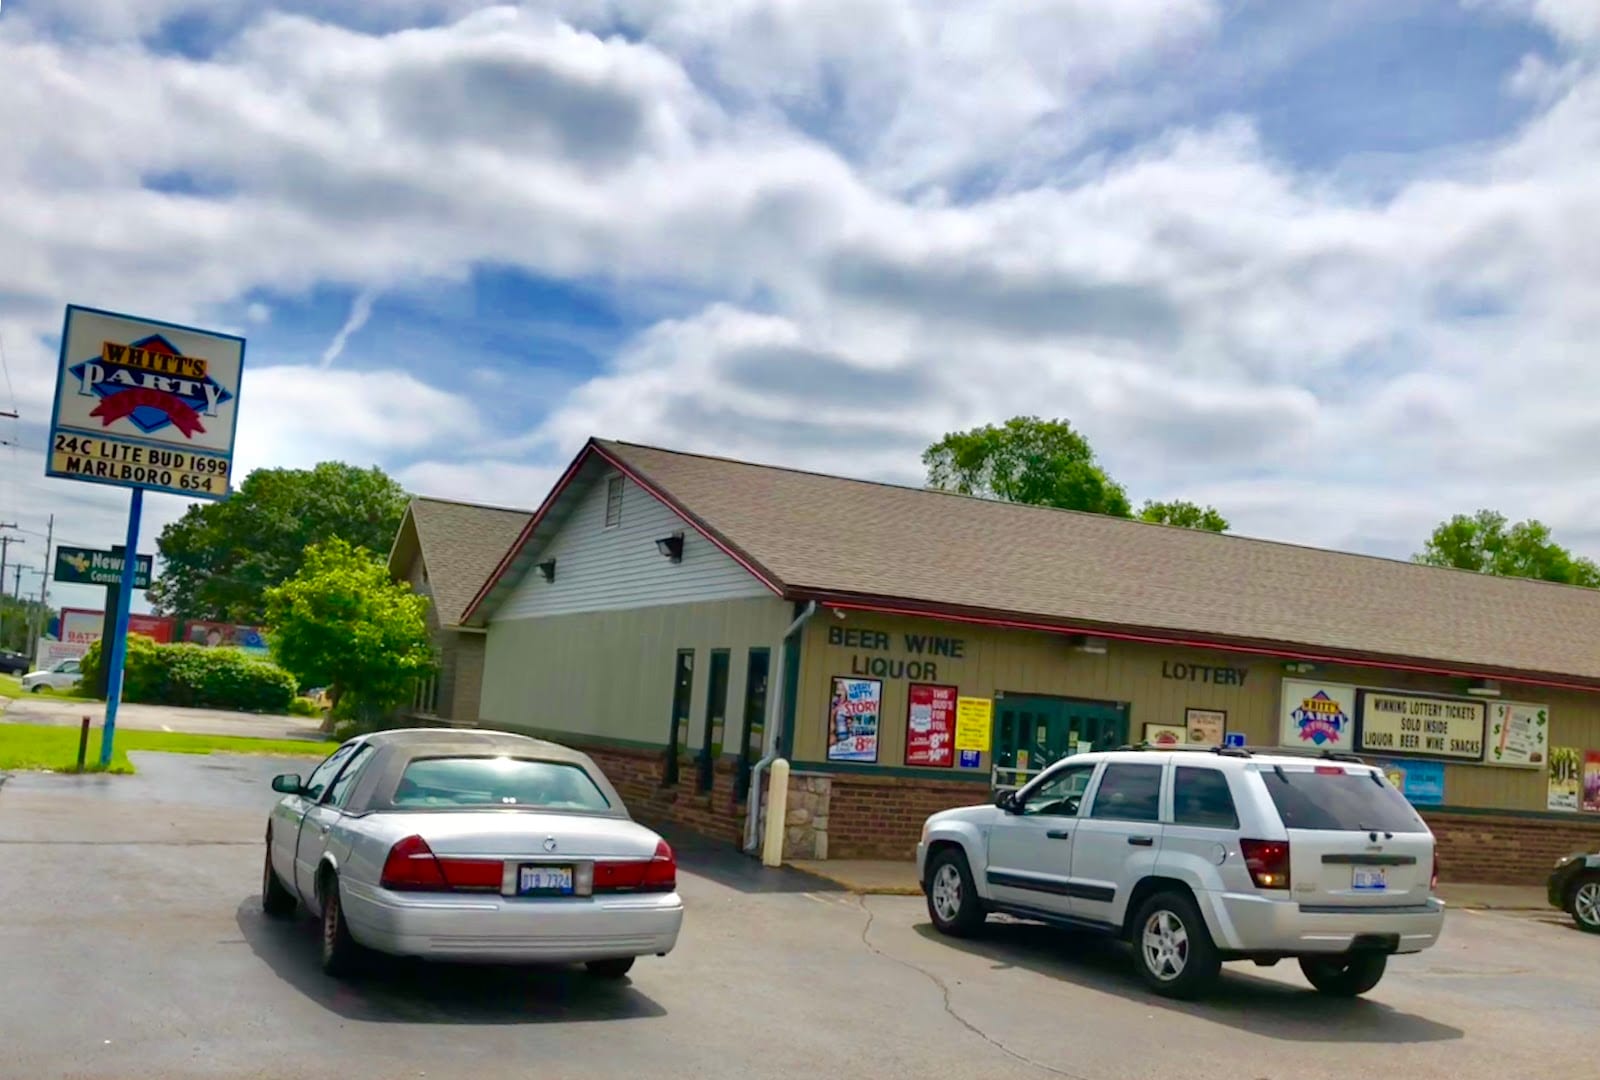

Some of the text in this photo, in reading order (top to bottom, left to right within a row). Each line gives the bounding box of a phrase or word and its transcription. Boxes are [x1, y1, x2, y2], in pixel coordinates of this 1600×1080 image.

[106, 342, 205, 376] WHITT'S
[79, 362, 226, 417] PARTY
[55, 434, 228, 476] 24C LITE BUD 1699
[66, 456, 212, 492] MARLBORO 654
[828, 625, 965, 658] BEER WINE
[851, 654, 937, 681] LIQUOR
[1161, 660, 1249, 687] LOTTERY
[844, 700, 877, 715] STORY
[1374, 698, 1476, 720] WINNING LOTTERY TICKETS
[1401, 718, 1448, 734] SOLD INSIDE
[1364, 731, 1480, 753] LIQUOR BEER WINE SNACKS
